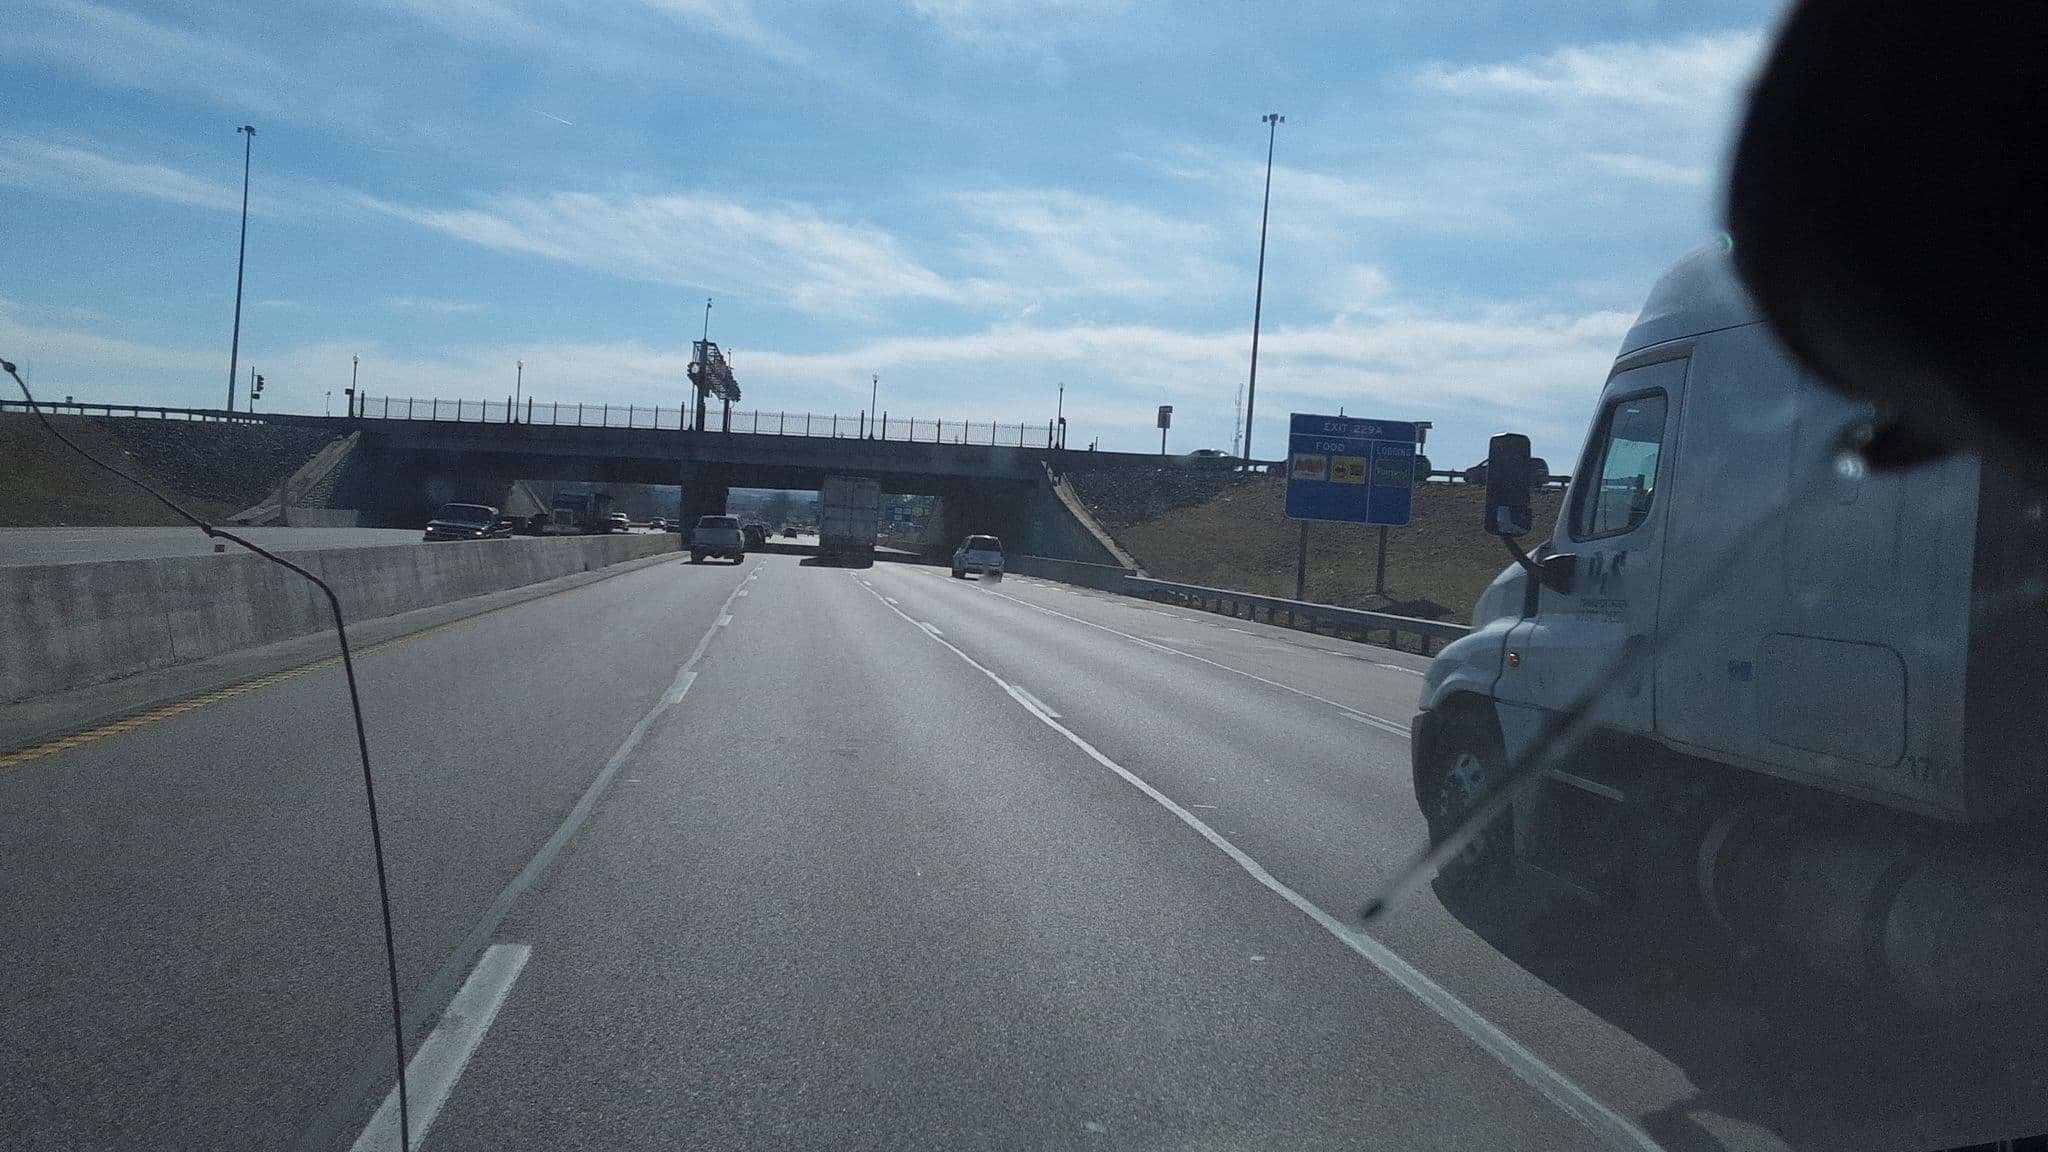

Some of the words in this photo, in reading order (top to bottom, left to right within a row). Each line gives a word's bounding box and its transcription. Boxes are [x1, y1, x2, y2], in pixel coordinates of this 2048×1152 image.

[1323, 422, 1348, 433] EXIT
[1353, 423, 1383, 435] 229A
[1315, 441, 1345, 453] FOOD
[1376, 446, 1412, 457] LODGING
